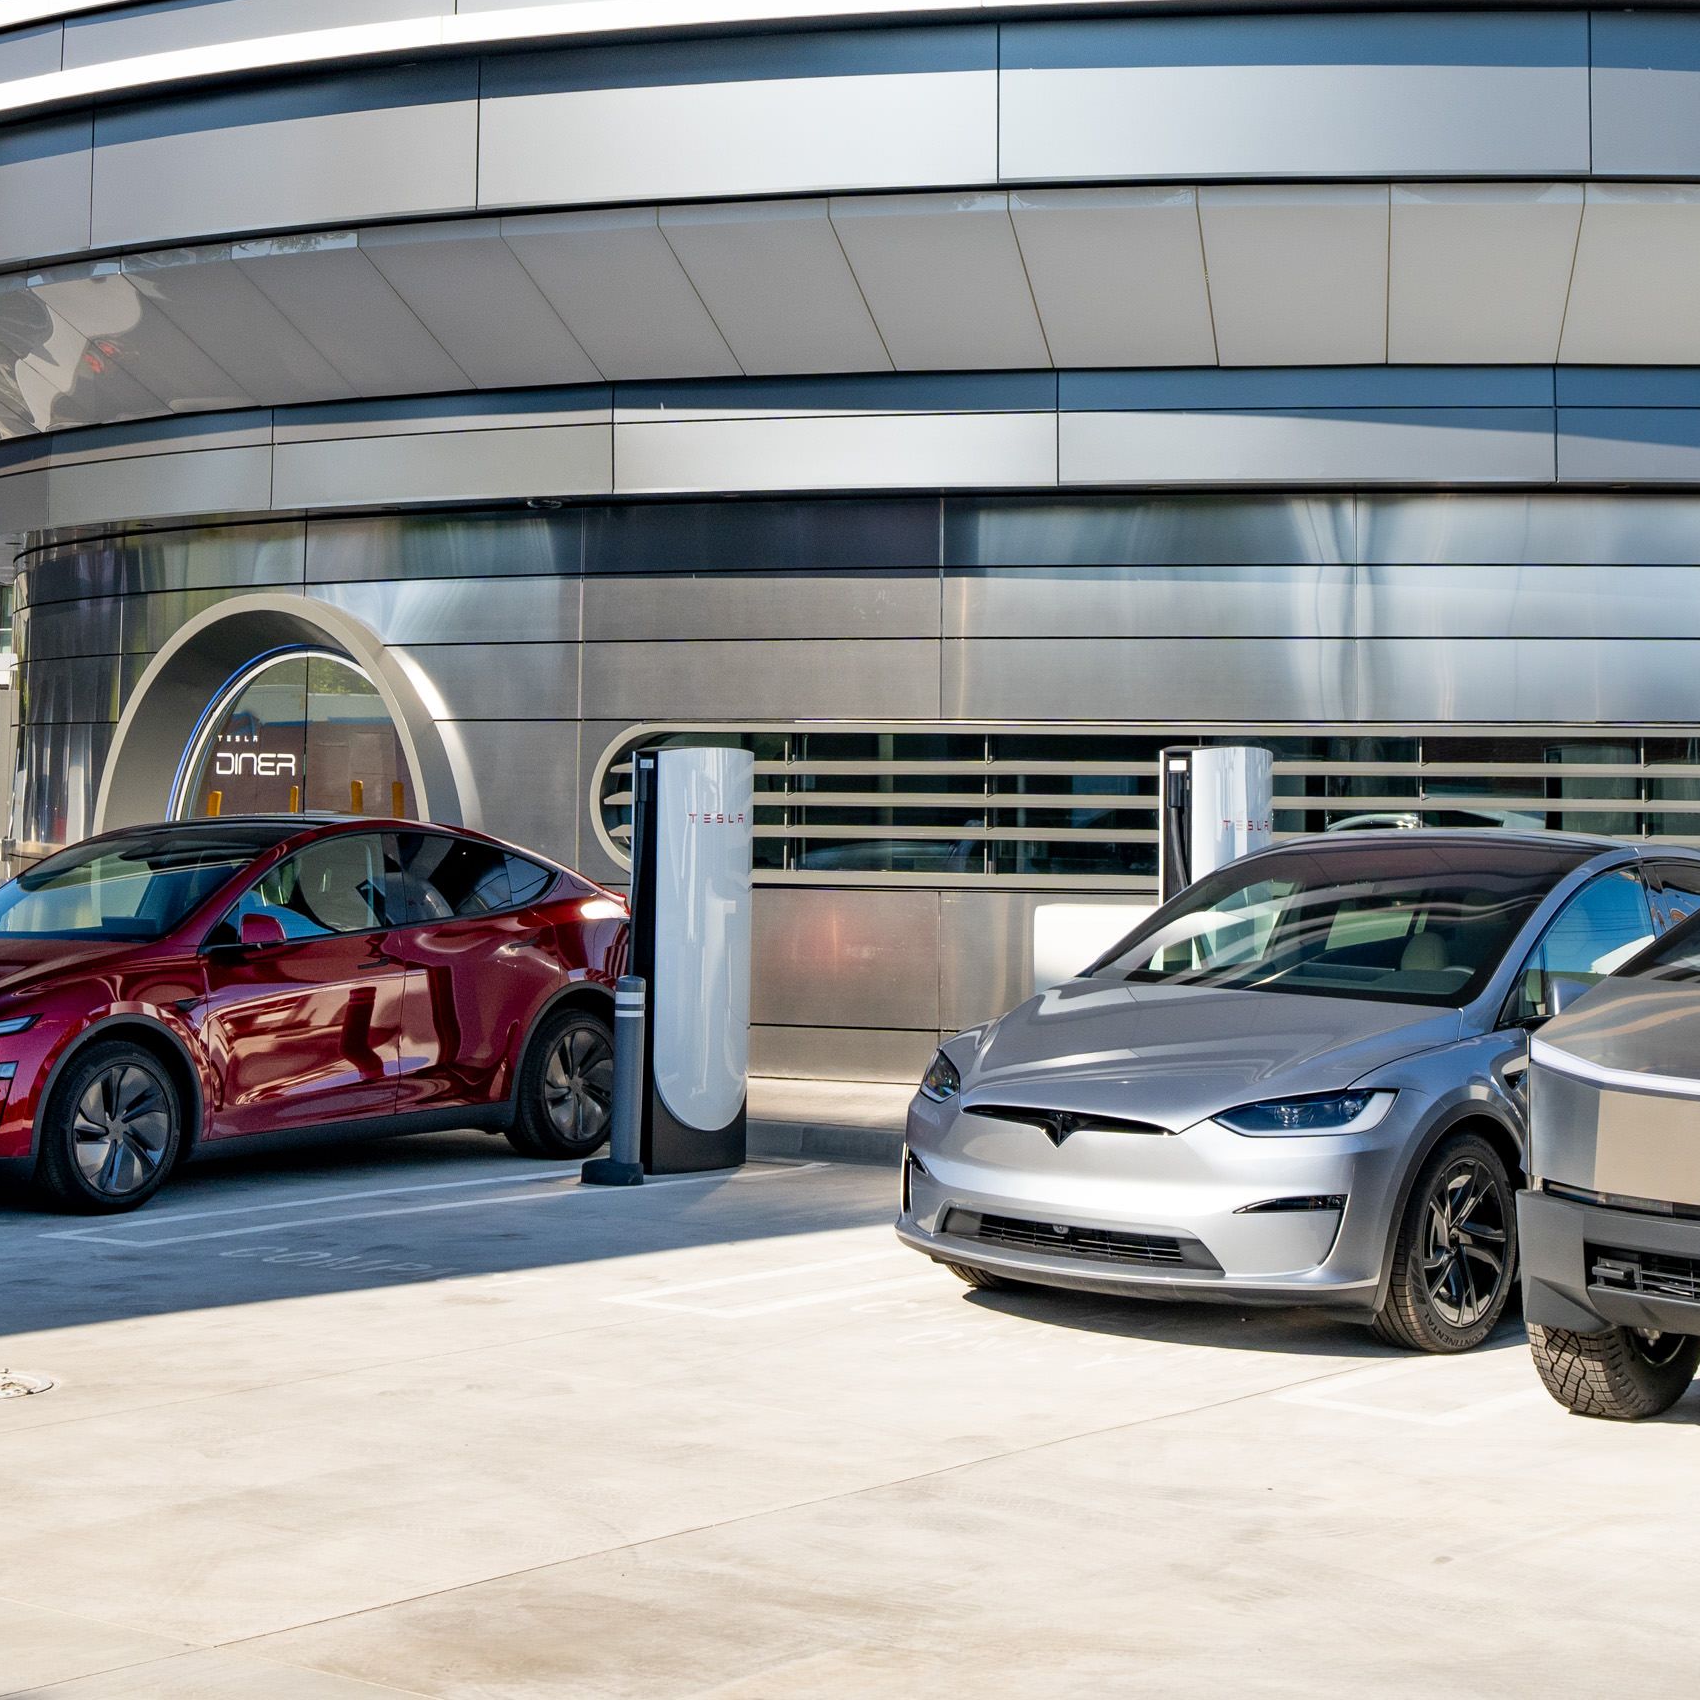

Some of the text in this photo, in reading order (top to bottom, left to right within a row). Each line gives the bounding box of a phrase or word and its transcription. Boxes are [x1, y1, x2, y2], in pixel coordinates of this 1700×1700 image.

[217, 734, 259, 742] TESLA
[216, 752, 296, 776] DINER
[688, 813, 744, 823] TESLA
[1222, 820, 1270, 831] TESLA
[1424, 1309, 1485, 1348] CONTINENTAL
